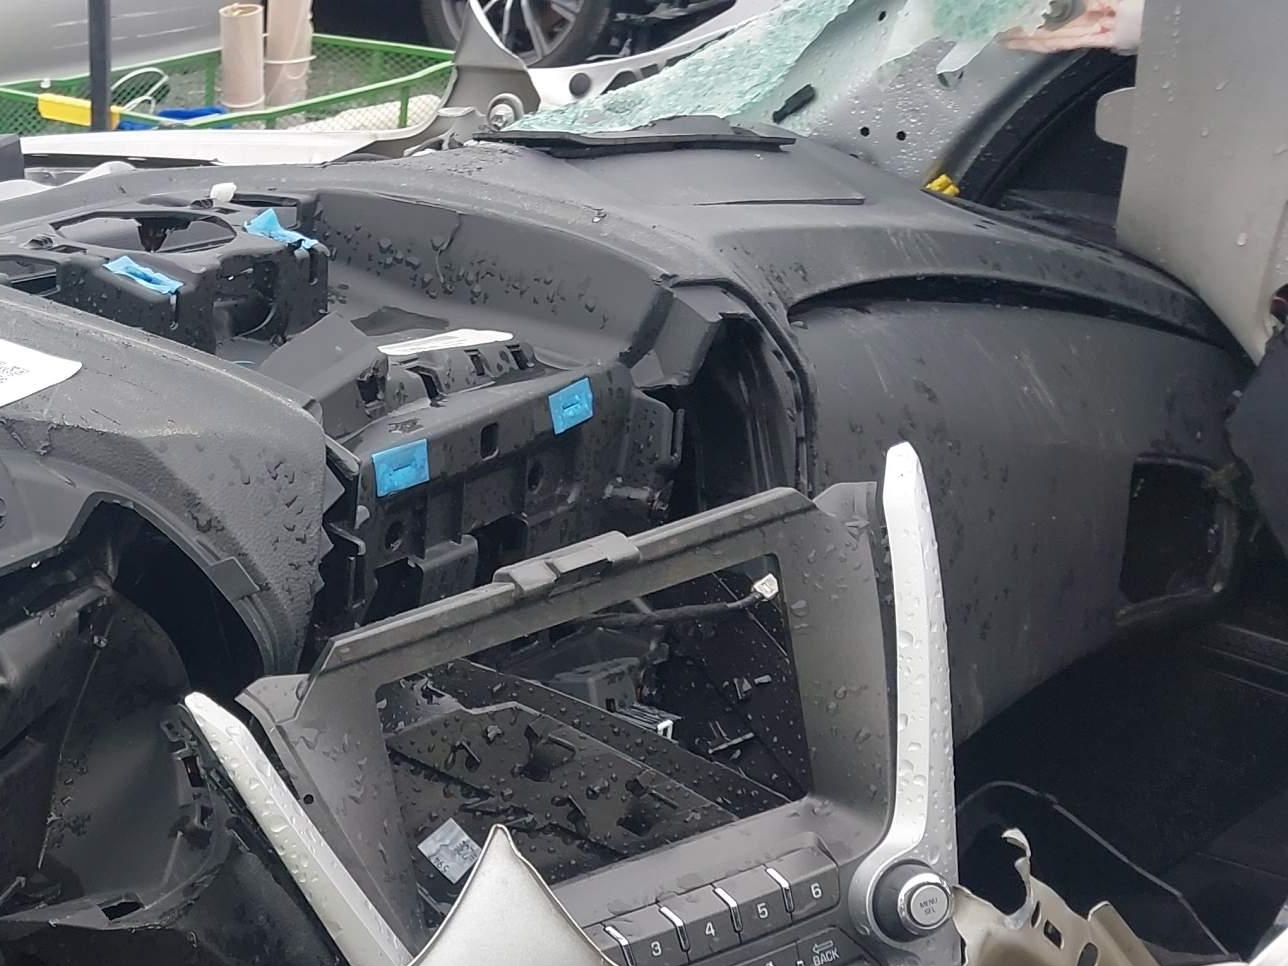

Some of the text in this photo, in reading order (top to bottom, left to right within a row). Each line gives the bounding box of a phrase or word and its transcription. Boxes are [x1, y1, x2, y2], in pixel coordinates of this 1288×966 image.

[811, 883, 823, 898] 6
[757, 903, 768, 918] 5
[919, 897, 938, 909] MENU
[705, 922, 715, 936] 4
[650, 941, 662, 956] 3
[813, 948, 840, 966] BACK
